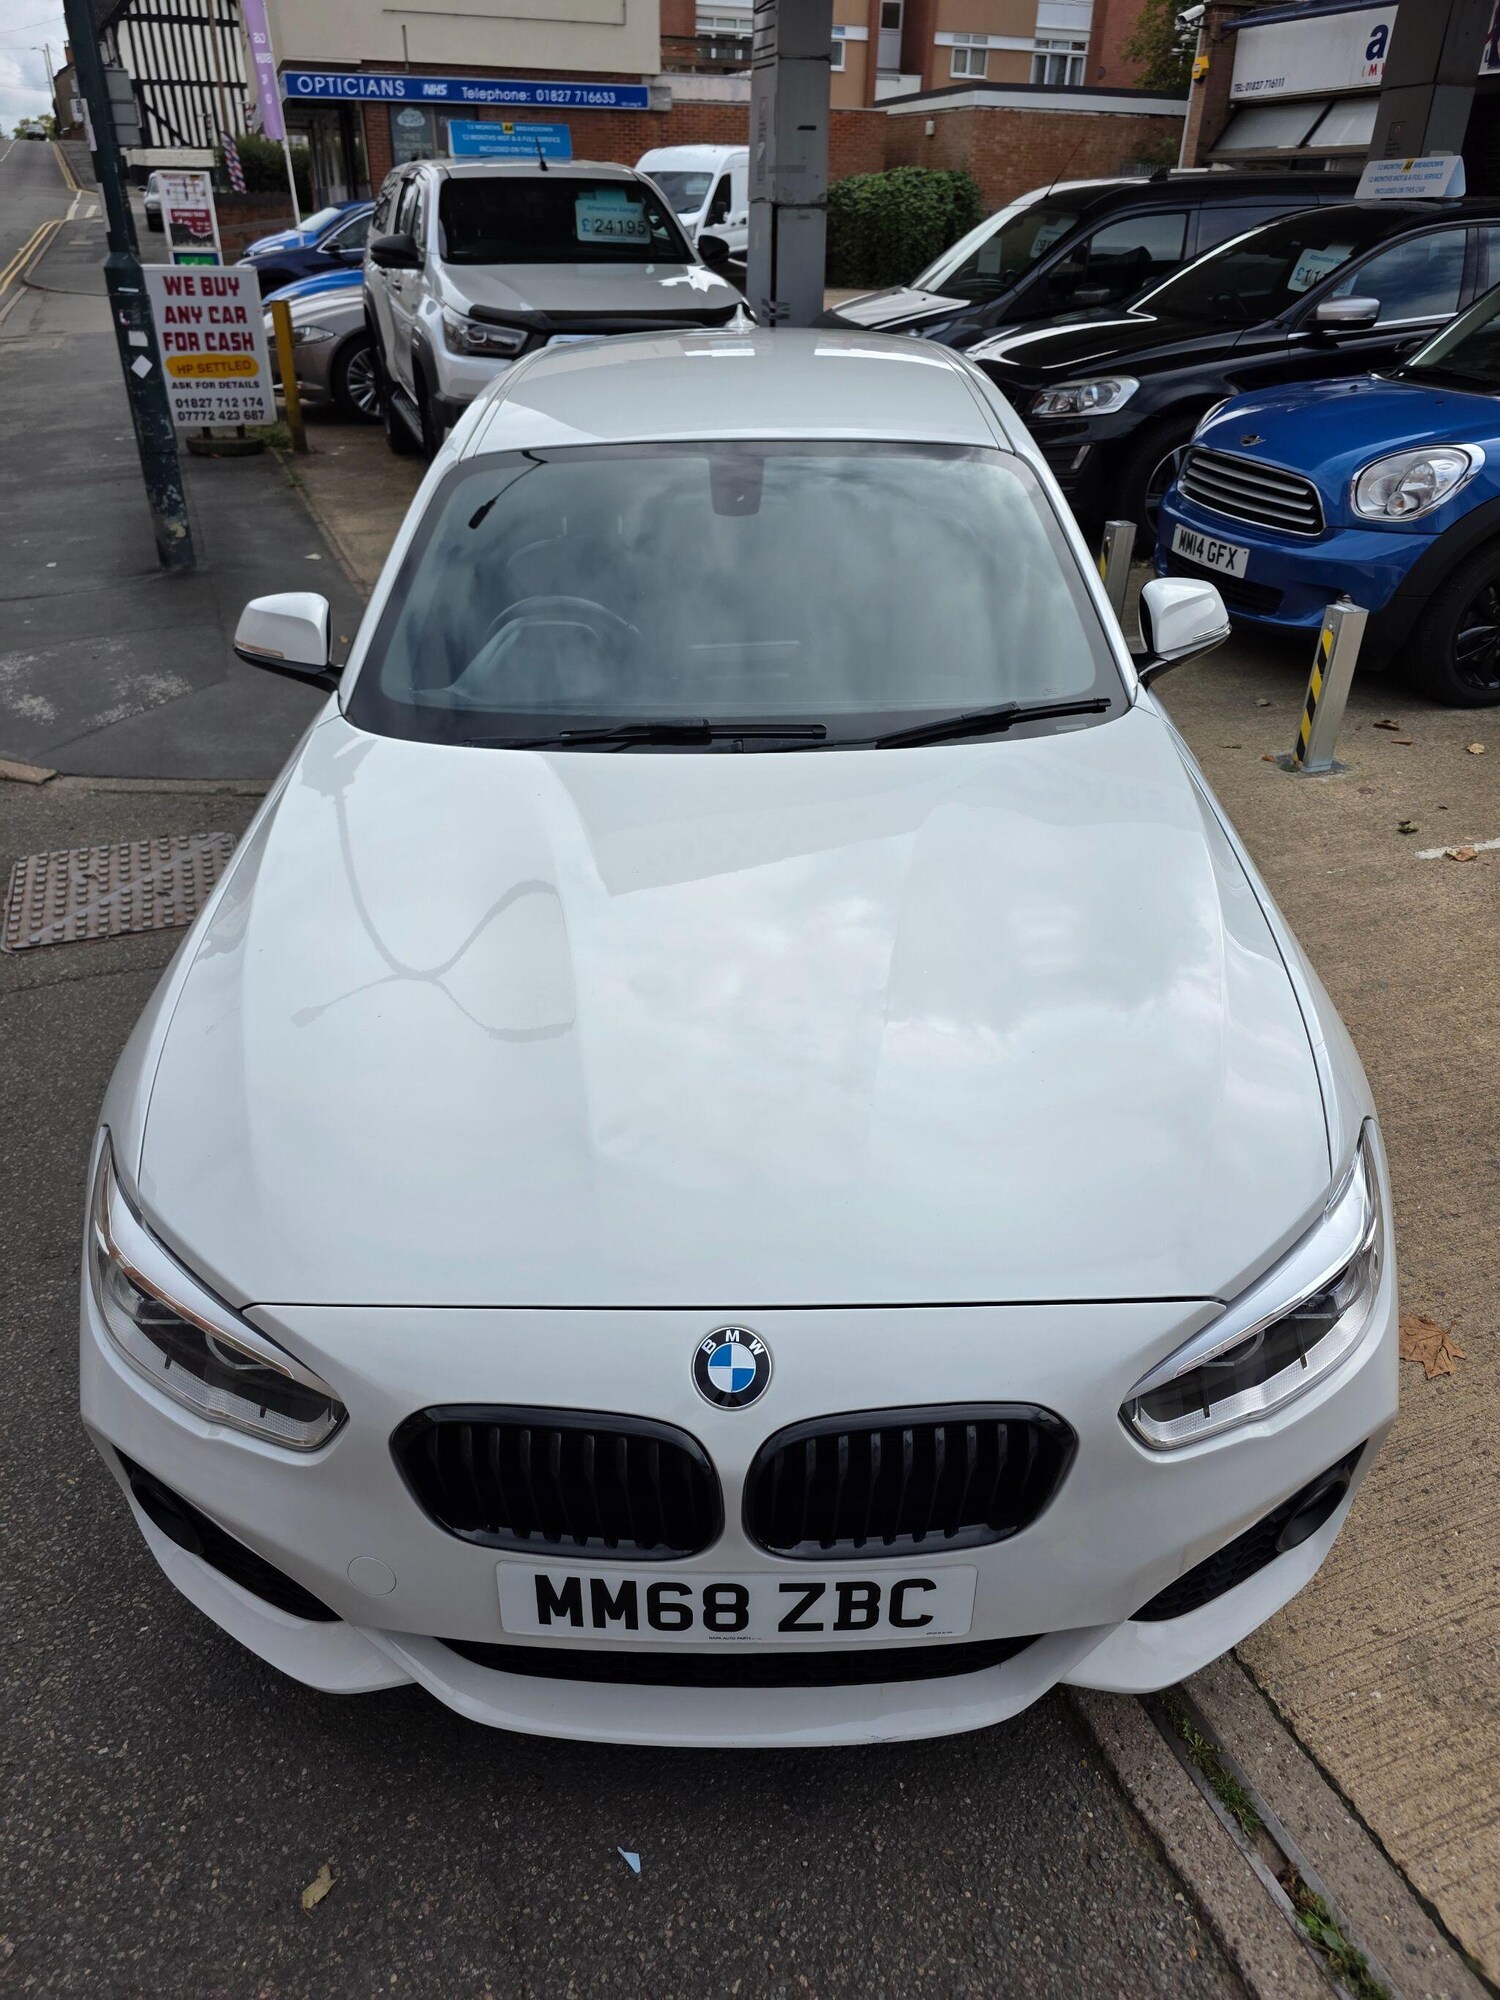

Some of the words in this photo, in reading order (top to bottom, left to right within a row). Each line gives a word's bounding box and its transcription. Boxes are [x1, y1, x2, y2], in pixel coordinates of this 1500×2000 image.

[1365, 24, 1389, 61] a
[297, 76, 405, 97] OPTICIANS
[422, 83, 448, 96] NHS
[461, 86, 531, 102] Telephone:
[535, 89, 571, 103] 01827
[575, 90, 616, 104] 716633
[1245, 80, 1263, 92] 01827
[1263, 77, 1285, 90] 716111
[581, 217, 647, 235] £24195
[162, 276, 196, 296] WE
[200, 276, 240, 296] BUY
[165, 305, 203, 324] ANY
[208, 305, 248, 324] CAR
[163, 332, 200, 351] FOR
[204, 332, 255, 351] CASH
[176, 364, 193, 375] HP
[197, 360, 252, 373] SETTLED
[172, 381, 193, 390] ASK
[196, 381, 216, 389] FOR
[217, 381, 260, 389] DETAILS
[175, 398, 212, 409] 01827
[216, 398, 239, 408] 712
[243, 397, 264, 408] 174
[177, 411, 215, 421] 07772
[219, 411, 241, 421] 423
[244, 410, 265, 420] 687
[1178, 529, 1205, 559] MM14
[1207, 541, 1238, 570] GFX
[701, 1329, 765, 1356] BMW
[534, 1574, 750, 1632] MM68
[777, 1577, 937, 1632] ZBC
